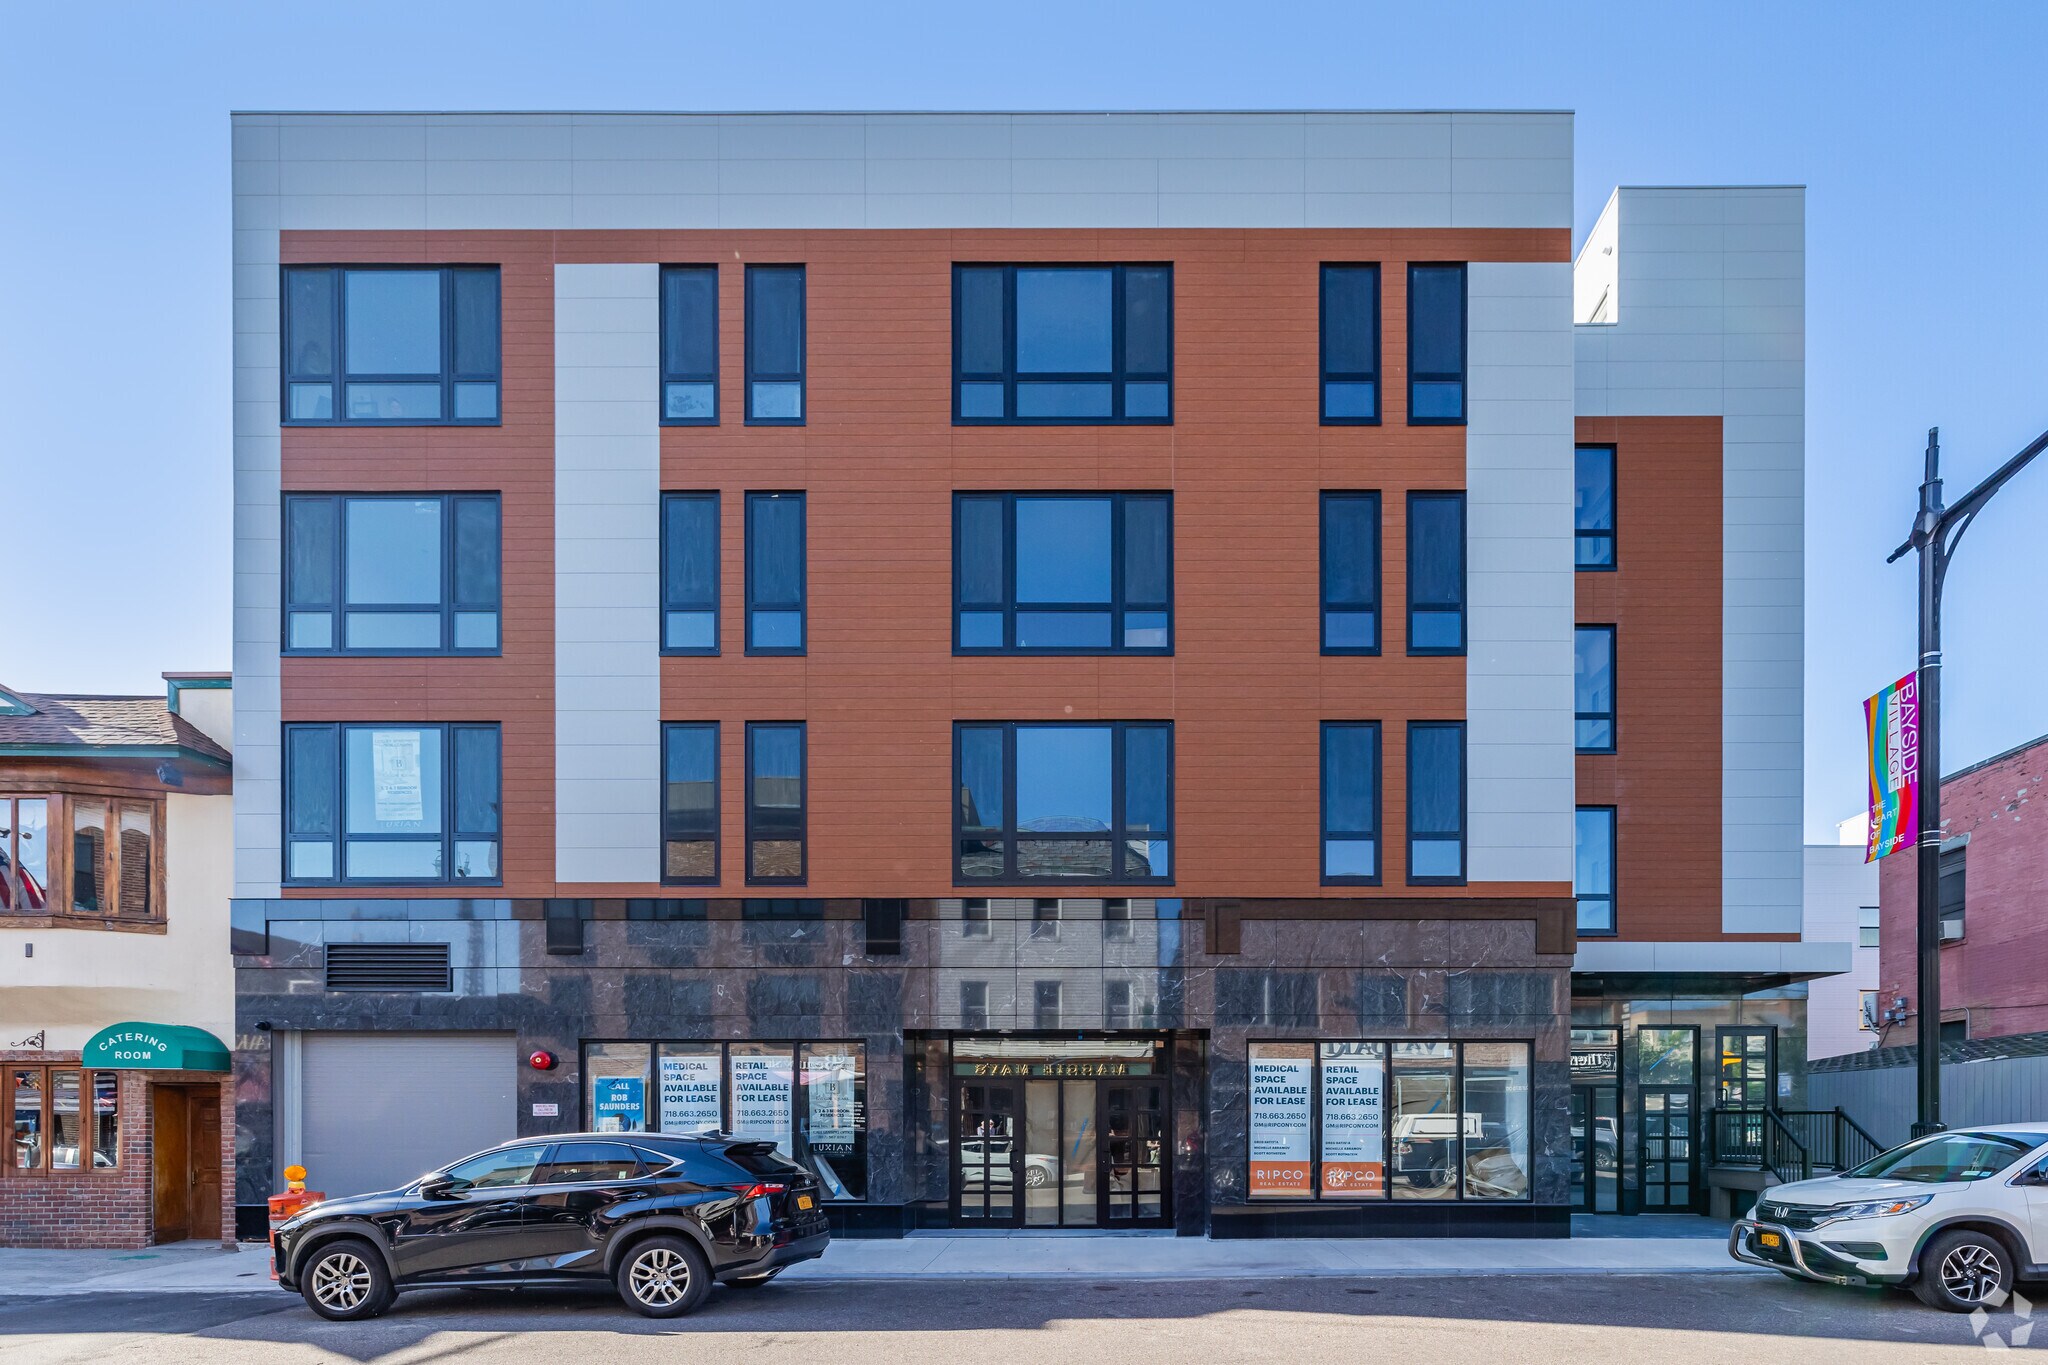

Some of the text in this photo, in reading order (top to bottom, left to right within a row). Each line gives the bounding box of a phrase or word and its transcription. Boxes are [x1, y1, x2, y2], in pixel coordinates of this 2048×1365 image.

[1888, 692, 1900, 790] VILLAGE
[1900, 682, 1918, 788] BAYSIDE
[1871, 800, 1886, 814] THE
[1870, 808, 1898, 826] HEART
[1869, 833, 1905, 854] BAYSIDE
[1870, 830, 1881, 841] OF
[99, 1032, 167, 1052] CATERING
[115, 1051, 151, 1059] ROOM
[1257, 1170, 1303, 1180] RIPCO
